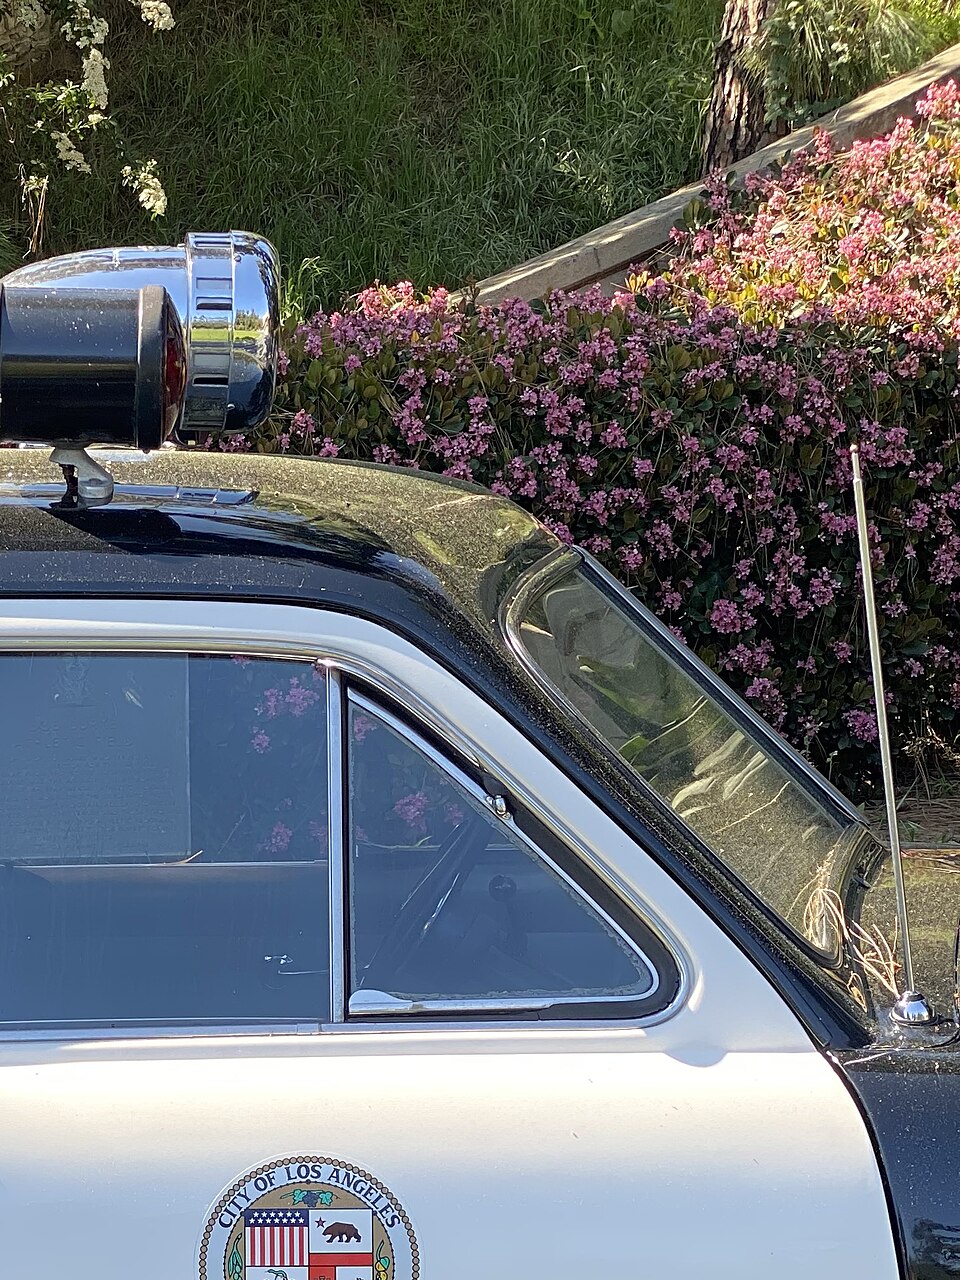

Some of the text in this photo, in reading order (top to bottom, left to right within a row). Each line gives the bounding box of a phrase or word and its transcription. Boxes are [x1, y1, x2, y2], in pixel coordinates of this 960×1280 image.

[218, 1164, 400, 1228] CITY OF LOS ANGELES
